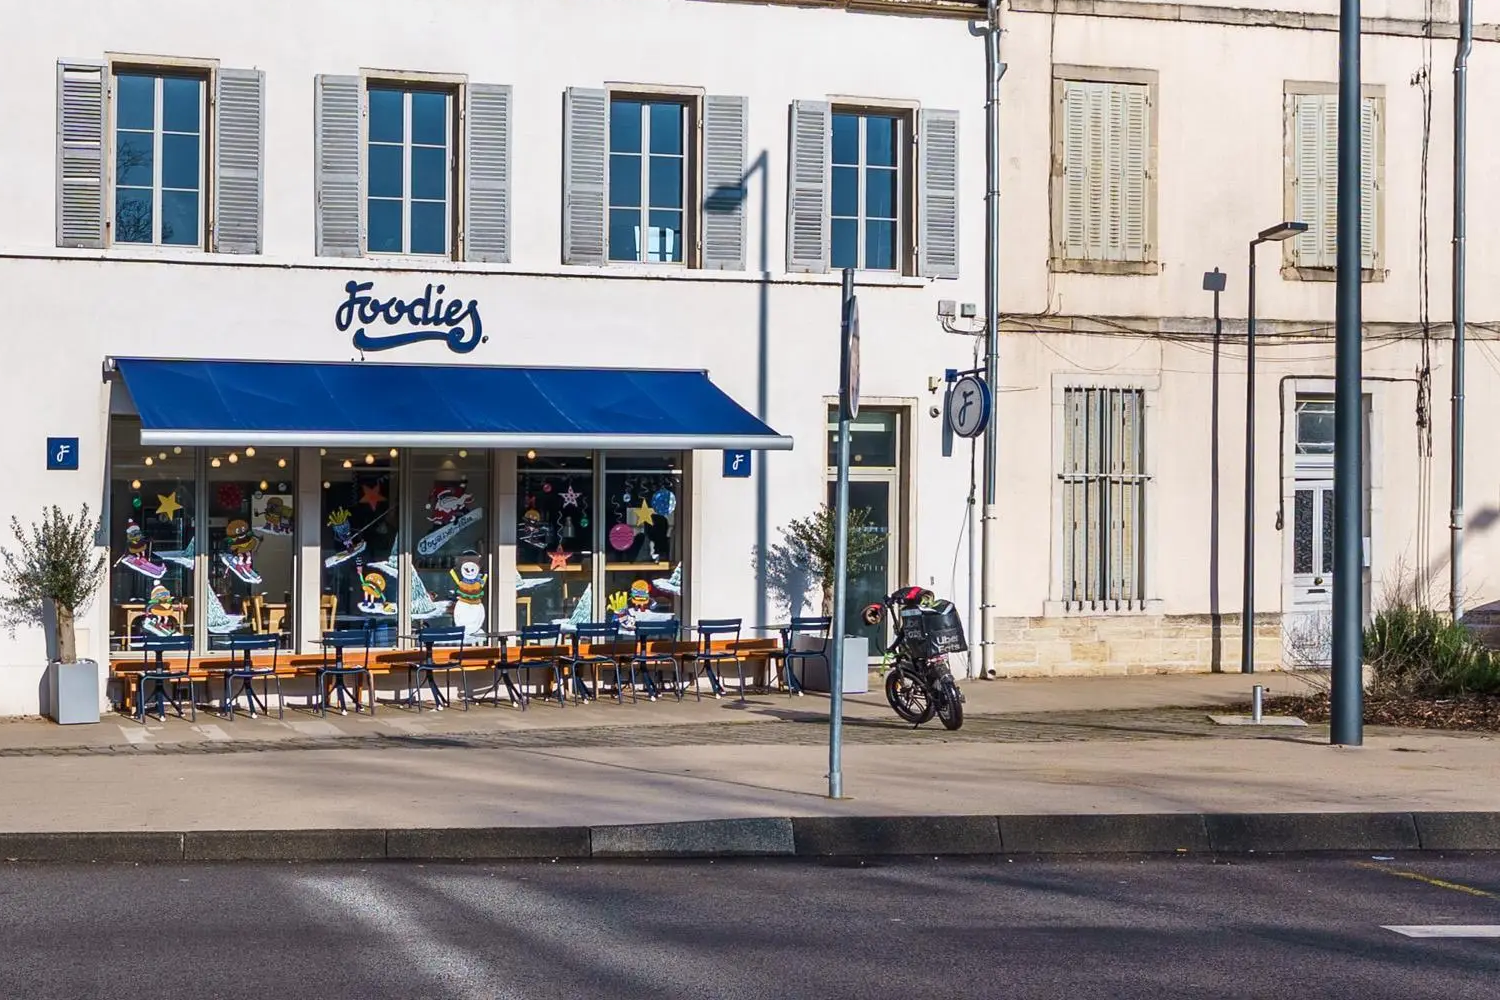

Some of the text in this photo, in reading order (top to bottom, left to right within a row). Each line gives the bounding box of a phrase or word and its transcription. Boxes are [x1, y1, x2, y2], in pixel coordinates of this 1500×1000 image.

[335, 280, 482, 353] Foodies
[936, 635, 958, 645] Uber
[938, 645, 960, 654] Eats
